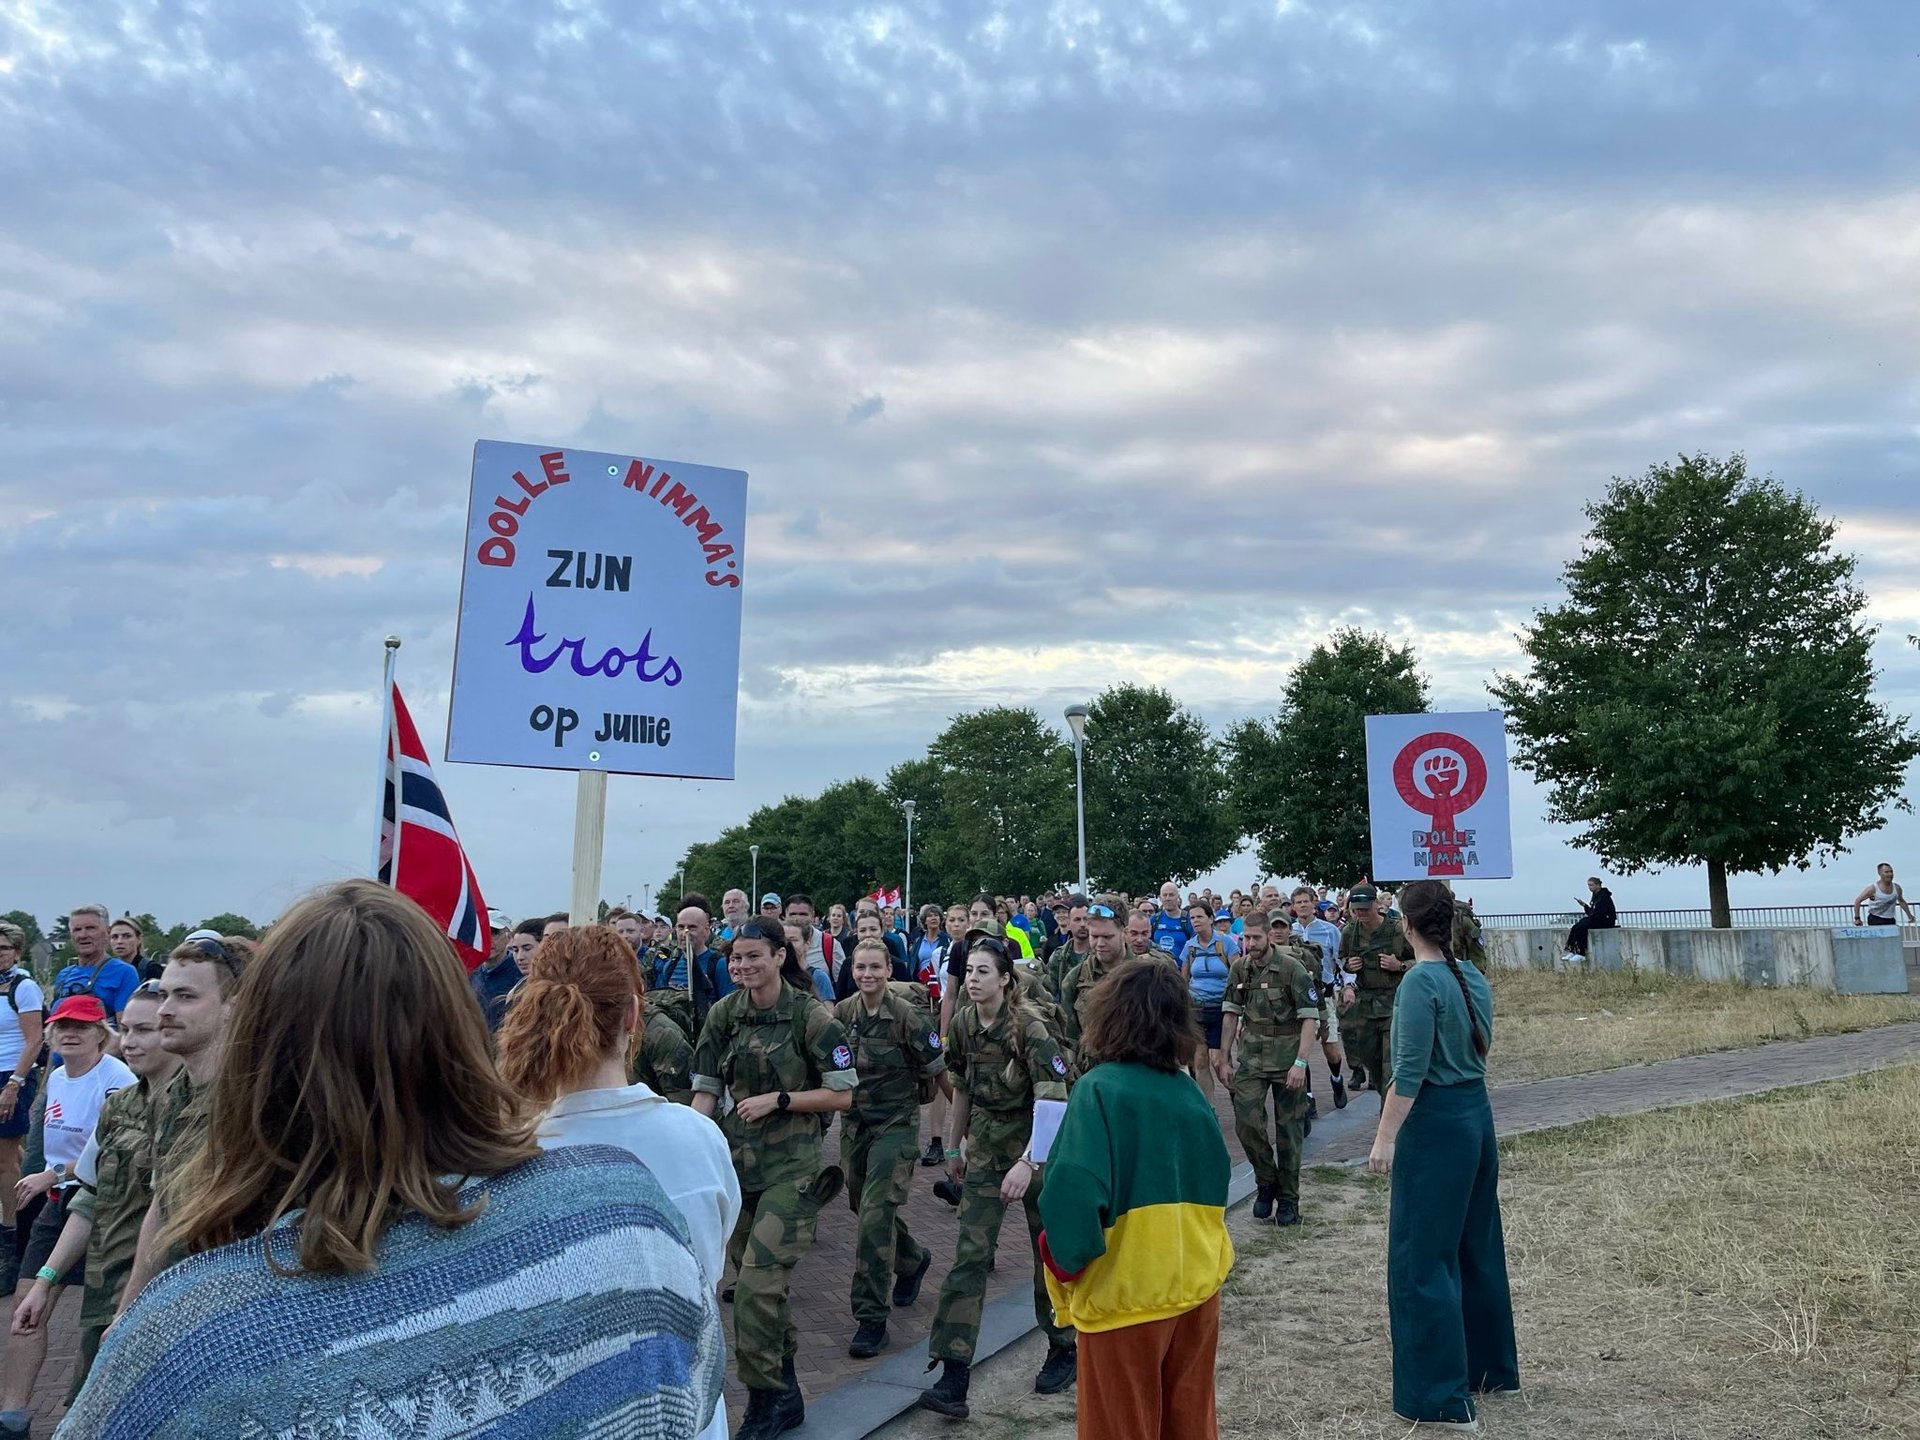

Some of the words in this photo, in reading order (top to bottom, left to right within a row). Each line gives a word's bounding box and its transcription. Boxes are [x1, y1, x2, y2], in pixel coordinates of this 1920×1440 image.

[477, 451, 570, 567] DOLLE
[623, 459, 740, 588] NIMMA'S
[546, 549, 632, 592] ZIJN
[504, 591, 682, 687] trots
[530, 704, 579, 747] op
[1412, 829, 1476, 847] DOLLE
[1413, 851, 1479, 867] NIMMA
